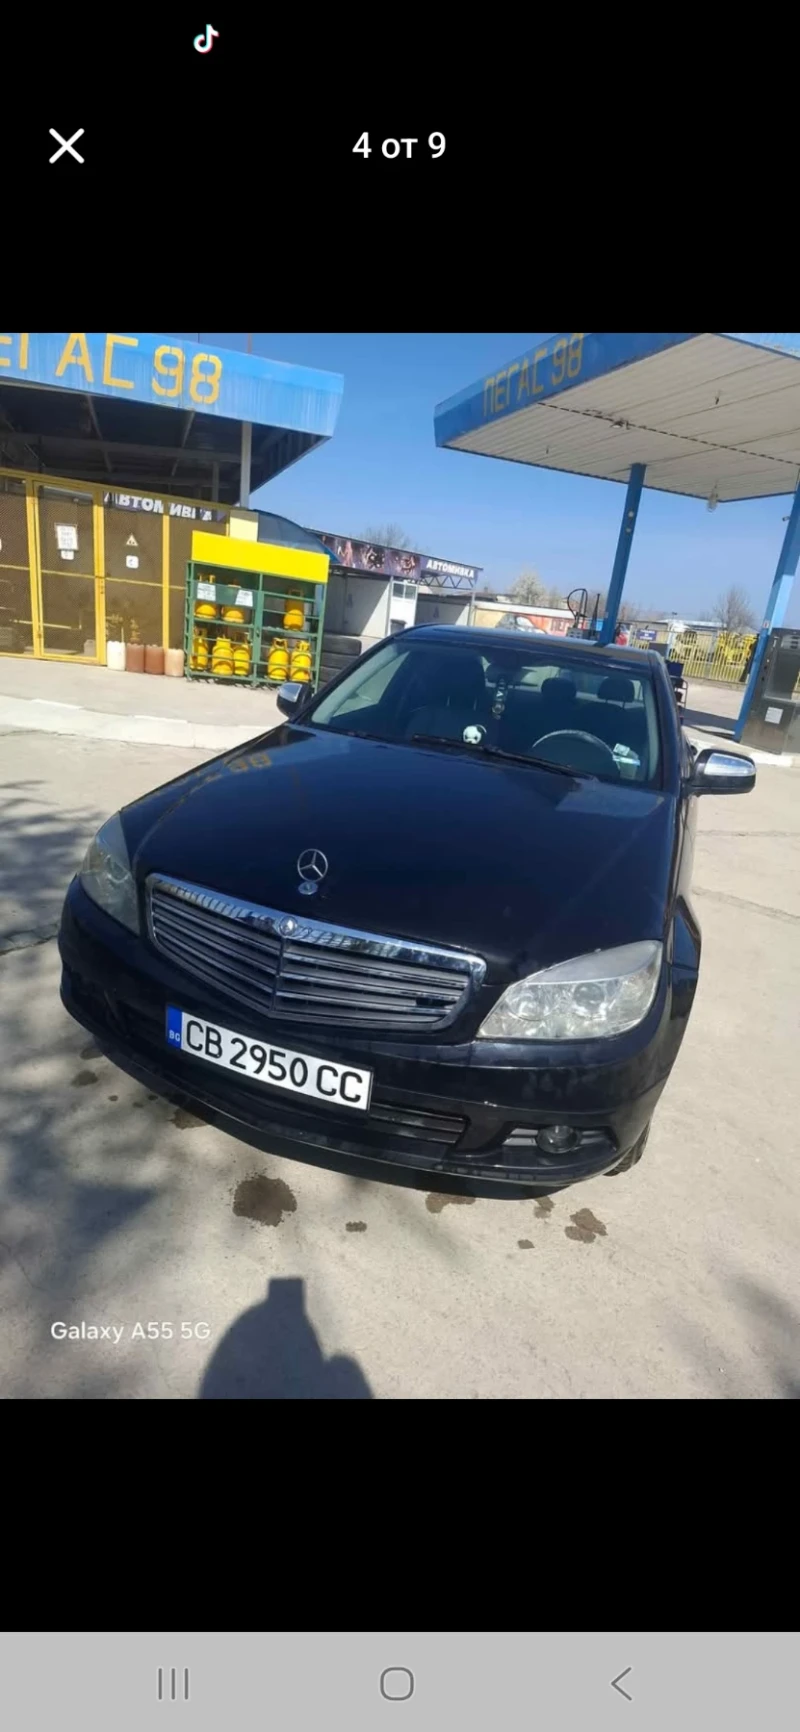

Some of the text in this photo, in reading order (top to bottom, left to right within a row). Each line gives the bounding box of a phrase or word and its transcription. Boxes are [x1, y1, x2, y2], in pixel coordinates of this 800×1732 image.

[151, 344, 223, 405] 98
[483, 333, 585, 417] ПЕГАС 98
[426, 559, 475, 578] АВТОМИВКА
[168, 1029, 181, 1042] BG
[186, 1019, 364, 1104] CB 2950 CC
